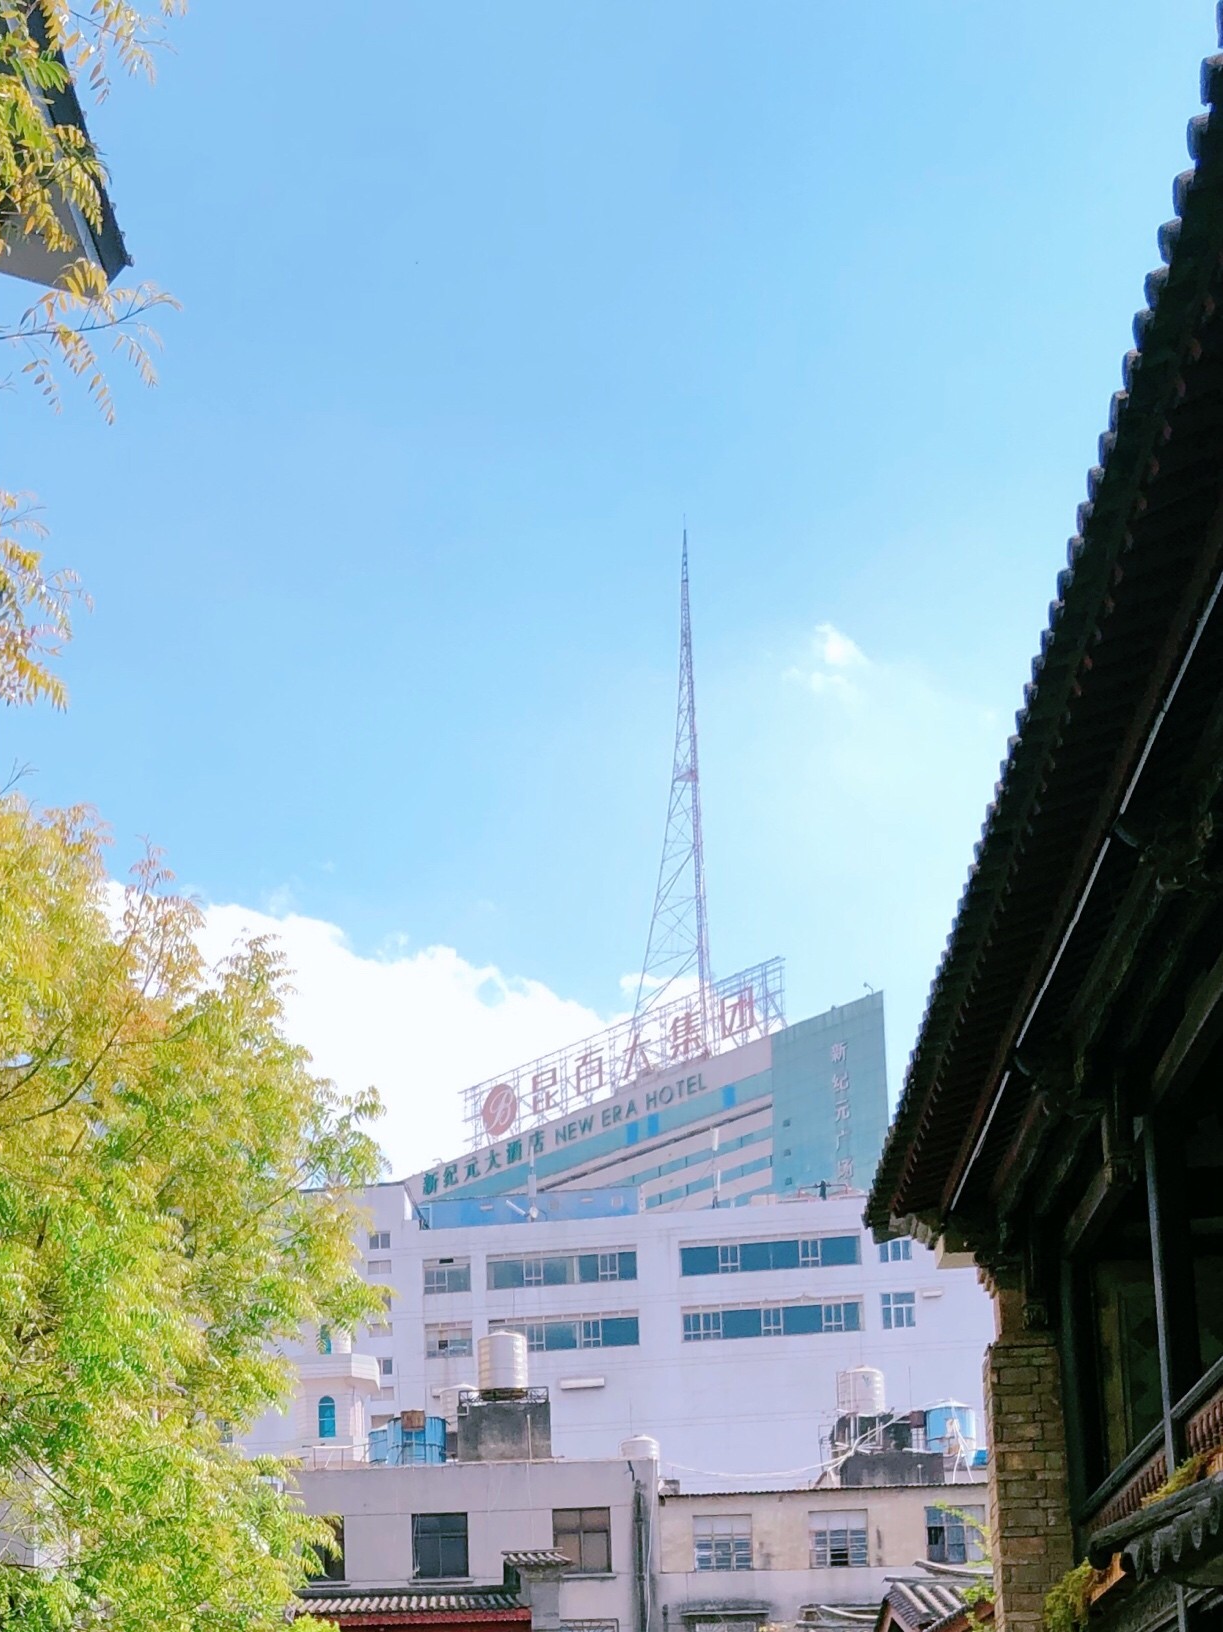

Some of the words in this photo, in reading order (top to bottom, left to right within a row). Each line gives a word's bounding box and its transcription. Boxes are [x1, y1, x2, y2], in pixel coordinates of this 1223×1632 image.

[532, 986, 754, 1116] 昆百大集团
[554, 1114, 595, 1147] NEW
[601, 1100, 639, 1128] ERA
[645, 1072, 708, 1112] HOTEL
[831, 1041, 854, 1180] 新纪元广场
[422, 1130, 546, 1196] 新纪元大酒店
